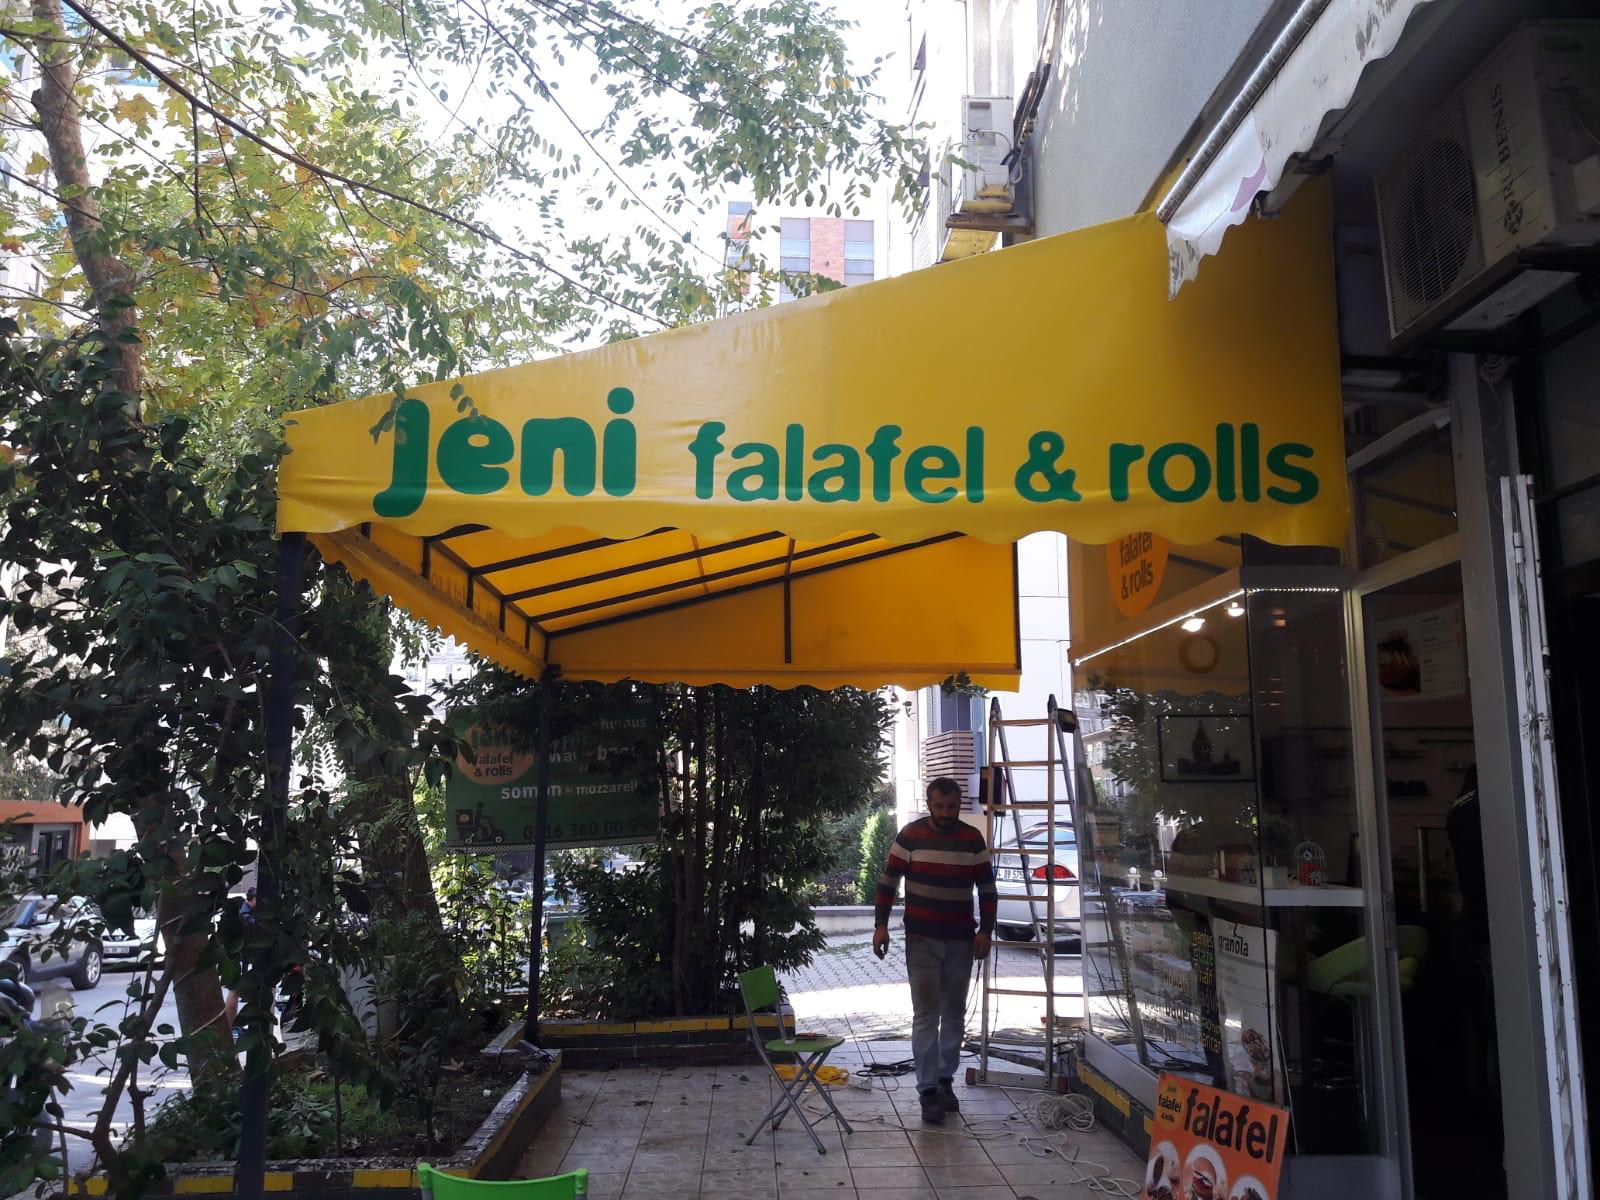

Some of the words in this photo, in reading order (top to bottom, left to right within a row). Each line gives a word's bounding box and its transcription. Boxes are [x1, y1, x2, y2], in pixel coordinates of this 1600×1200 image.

[1489, 84, 1515, 202] RUBENIS
[373, 387, 637, 518] Jeni
[688, 421, 984, 503] falafel
[1015, 431, 1082, 503] &
[1108, 422, 1320, 504] rolls
[1130, 558, 1153, 596] rolls
[485, 765, 513, 777] rolls
[1218, 934, 1249, 958] granola
[1184, 1087, 1278, 1164] falafel
